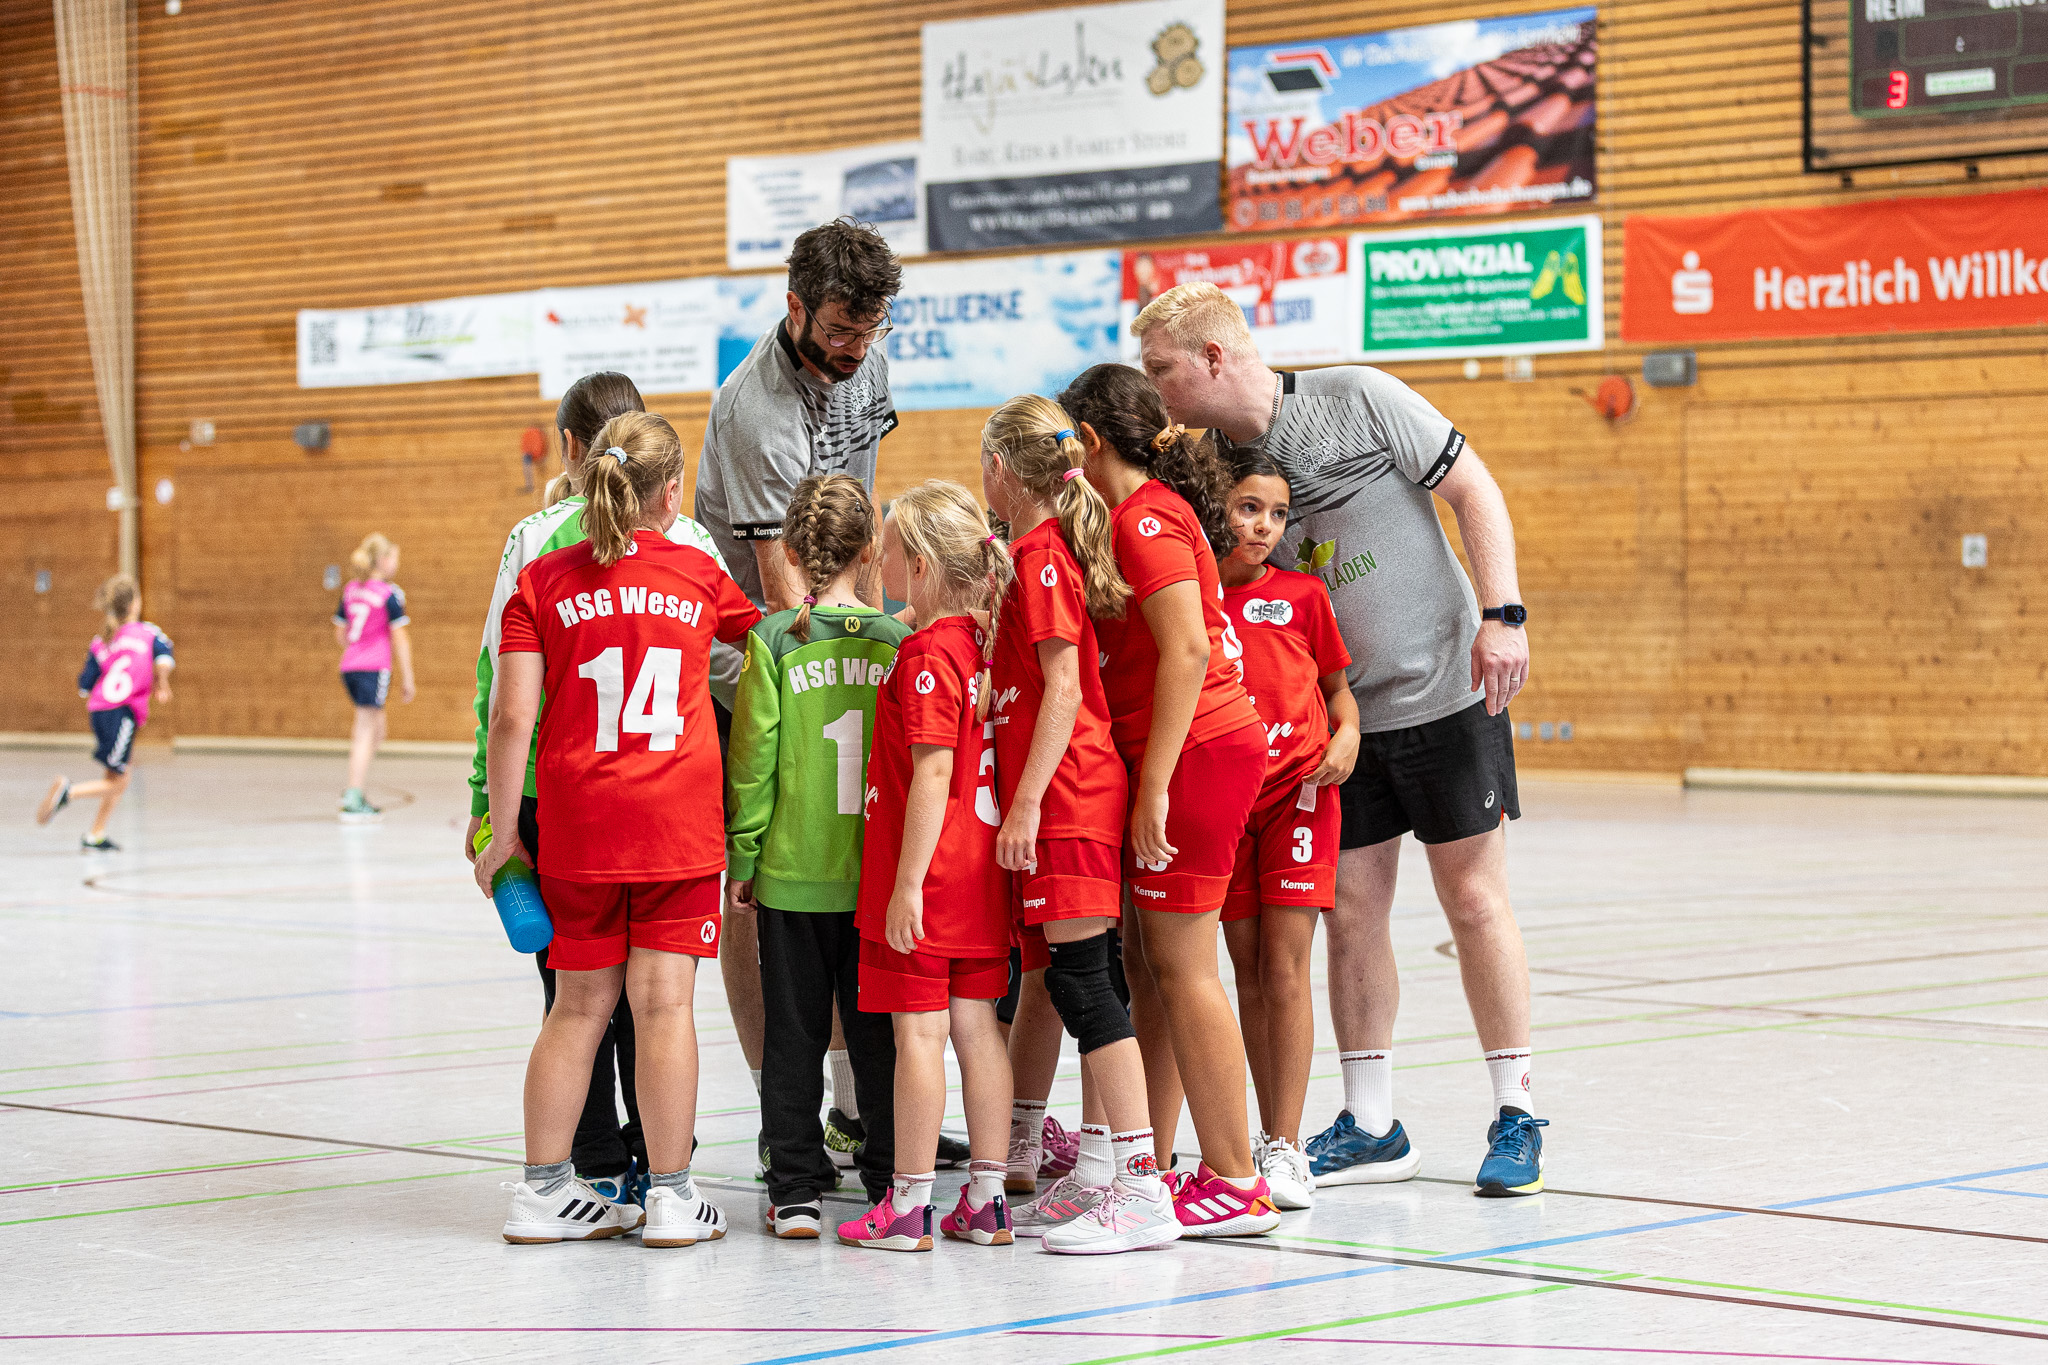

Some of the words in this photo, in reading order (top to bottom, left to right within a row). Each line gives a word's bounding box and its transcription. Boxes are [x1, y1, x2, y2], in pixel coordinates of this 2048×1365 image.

[1887, 71, 1909, 109] 3
[1241, 109, 1463, 171] Weber
[1370, 242, 1534, 282] PROVINZIAL
[1753, 257, 1921, 312] Herzlich
[1423, 463, 1448, 488] Kempa
[753, 527, 784, 538] Kempa
[348, 603, 371, 642] 7
[556, 588, 615, 629] HSG
[618, 586, 704, 629] Wesel
[101, 655, 134, 704] 6
[788, 658, 837, 695] HSG
[578, 646, 685, 753] 14
[823, 709, 863, 815] 1
[1292, 826, 1313, 863] 3
[1134, 885, 1167, 899] Kempa
[1280, 879, 1315, 892] Kempa
